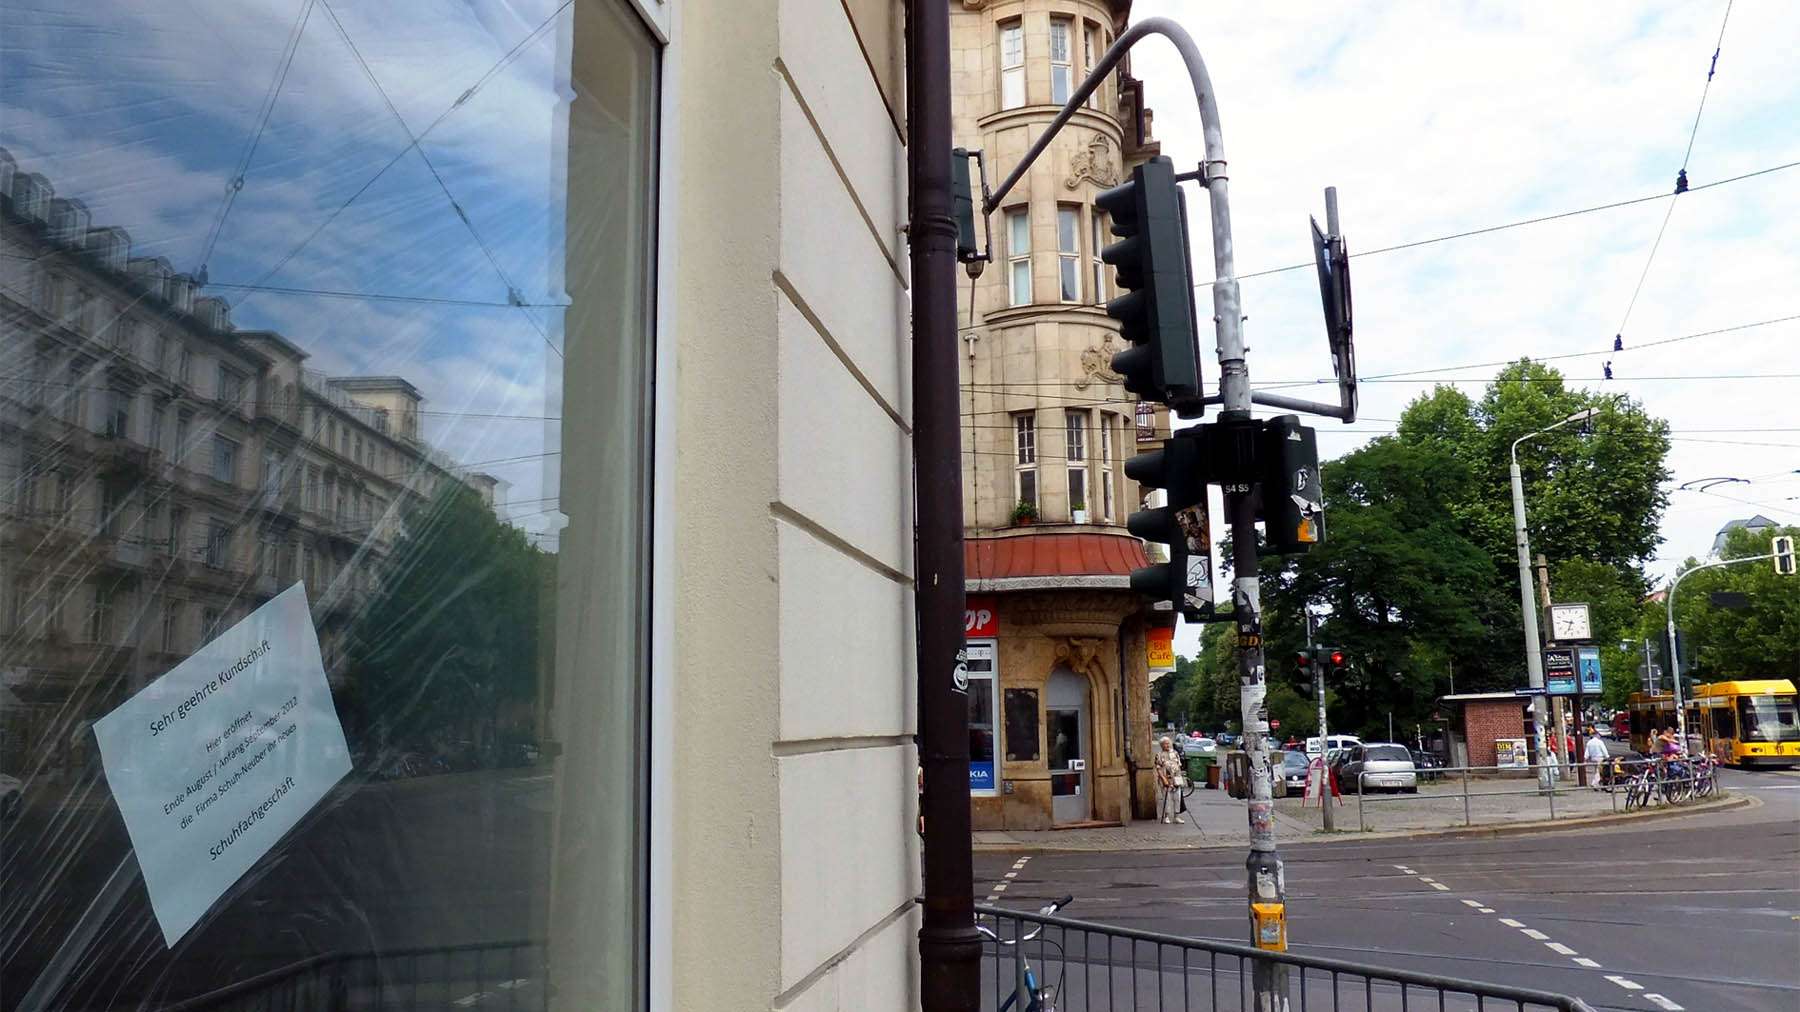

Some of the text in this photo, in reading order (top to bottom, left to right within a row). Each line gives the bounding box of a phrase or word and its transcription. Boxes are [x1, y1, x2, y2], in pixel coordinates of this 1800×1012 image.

[965, 609, 992, 631] OP
[149, 639, 272, 736] Sehr geehrte Kundschaft
[163, 793, 185, 816] Ende
[185, 769, 216, 798] August
[219, 742, 246, 769] Anfang
[244, 711, 281, 748] September
[280, 695, 298, 715] 2012
[206, 736, 222, 753] Hier
[970, 770, 989, 778] KIA
[180, 814, 194, 830] die
[195, 792, 219, 816] Firma
[277, 722, 297, 743] neues
